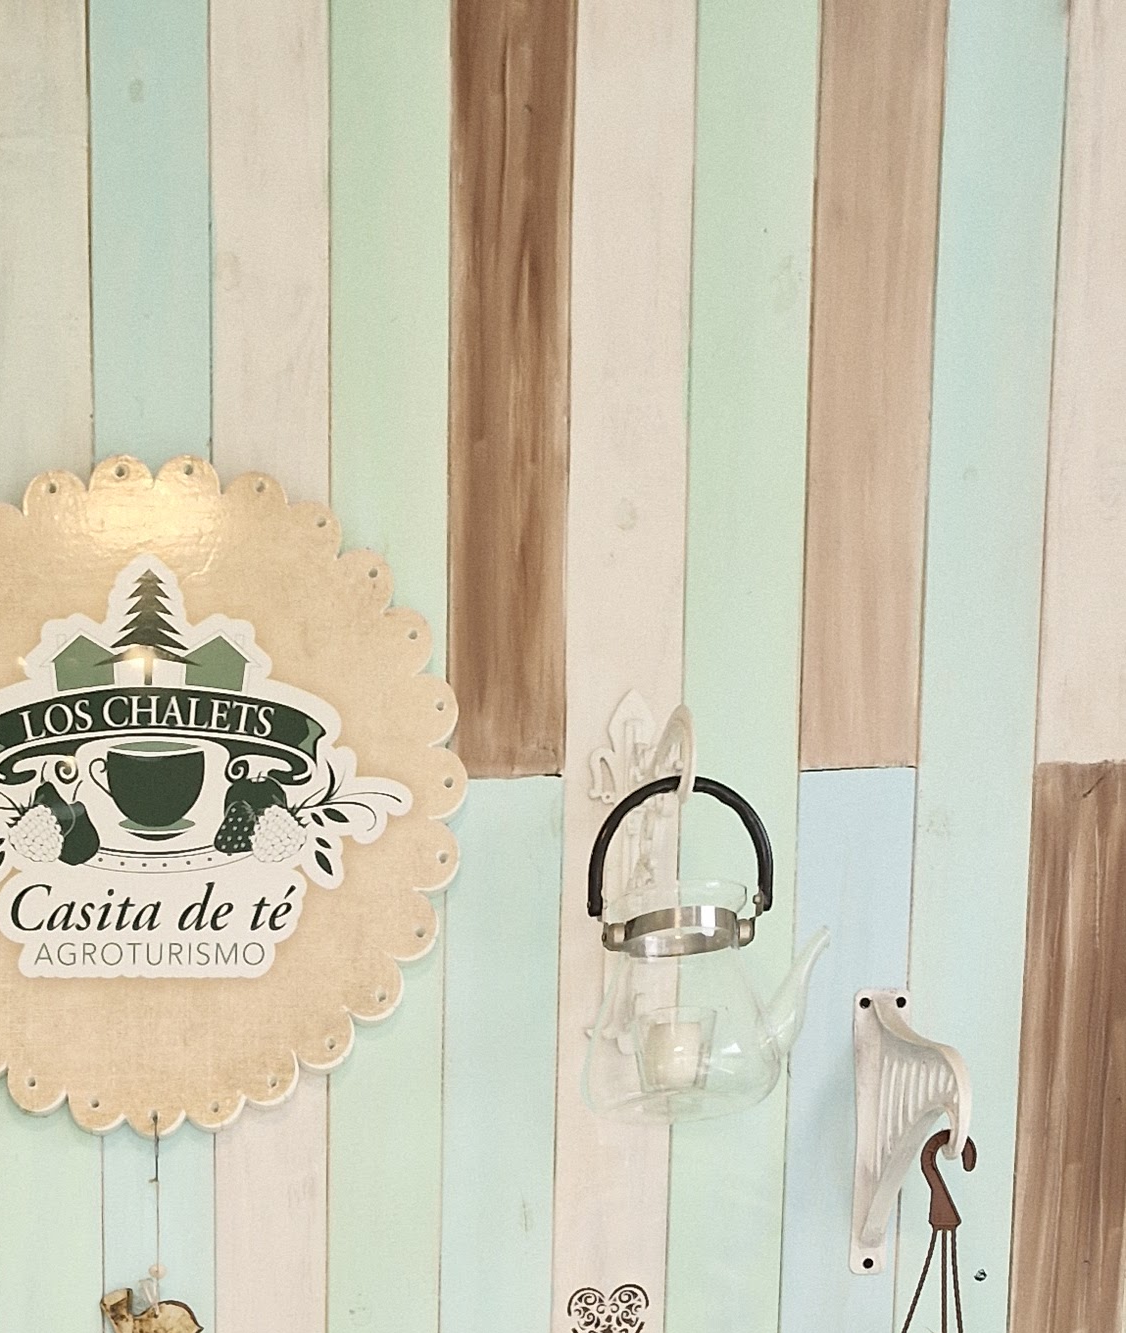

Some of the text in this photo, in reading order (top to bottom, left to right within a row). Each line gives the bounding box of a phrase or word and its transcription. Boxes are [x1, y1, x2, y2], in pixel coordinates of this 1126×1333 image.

[19, 695, 275, 741] LOS CHALETS
[10, 882, 296, 932] Casita de té
[34, 942, 265, 966] AGROTURISMO
